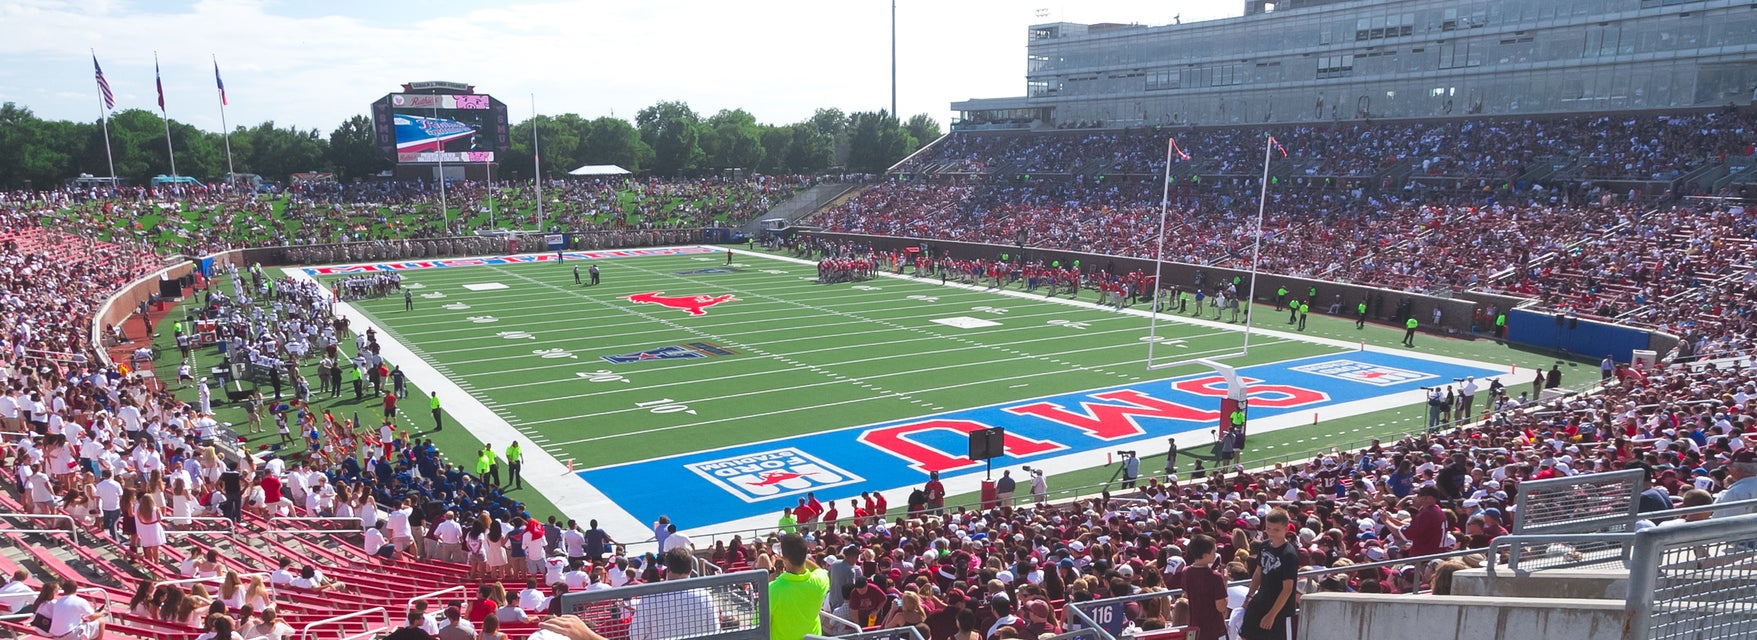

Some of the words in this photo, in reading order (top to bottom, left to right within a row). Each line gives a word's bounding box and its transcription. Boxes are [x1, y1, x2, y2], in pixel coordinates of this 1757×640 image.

[576, 370, 624, 382] 20
[635, 399, 689, 414] 10
[856, 375, 1331, 475] SMU
[702, 450, 795, 471] STADIUM
[714, 457, 807, 477] FORD
[1091, 605, 1113, 624] 116
